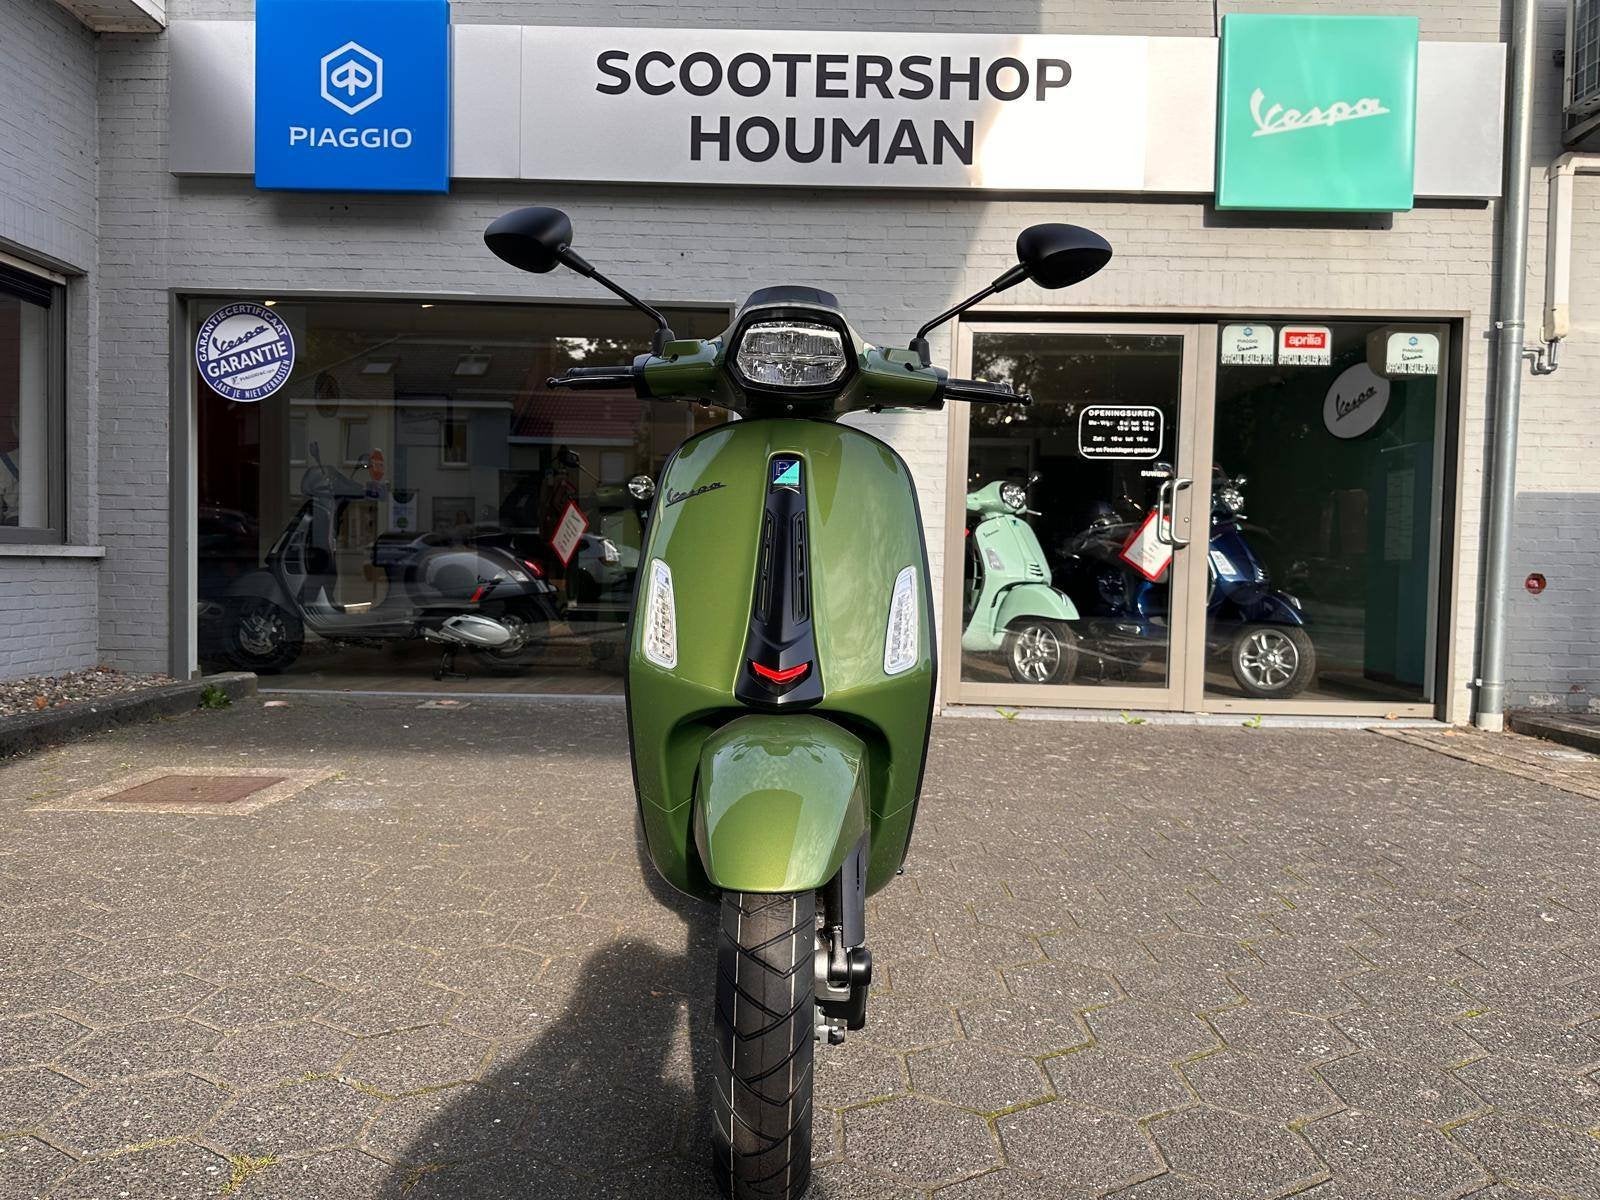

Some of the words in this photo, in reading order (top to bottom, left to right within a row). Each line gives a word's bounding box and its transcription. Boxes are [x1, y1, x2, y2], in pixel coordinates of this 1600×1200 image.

[596, 50, 1072, 102] SCOOTERSHOP
[1249, 87, 1391, 138] Vespa
[289, 126, 412, 149] PIAGGIO
[690, 115, 975, 166] HOUMAN
[199, 305, 288, 362] GARANTIECERTIFICAAT
[1289, 333, 1322, 346] aprilia
[207, 341, 288, 378] GARANTIE
[213, 379, 230, 395] LAAT
[232, 389, 241, 399] JE
[245, 389, 262, 399] NIET
[1088, 409, 1156, 418] OPENINGSUREN
[665, 482, 727, 508] Vespa
